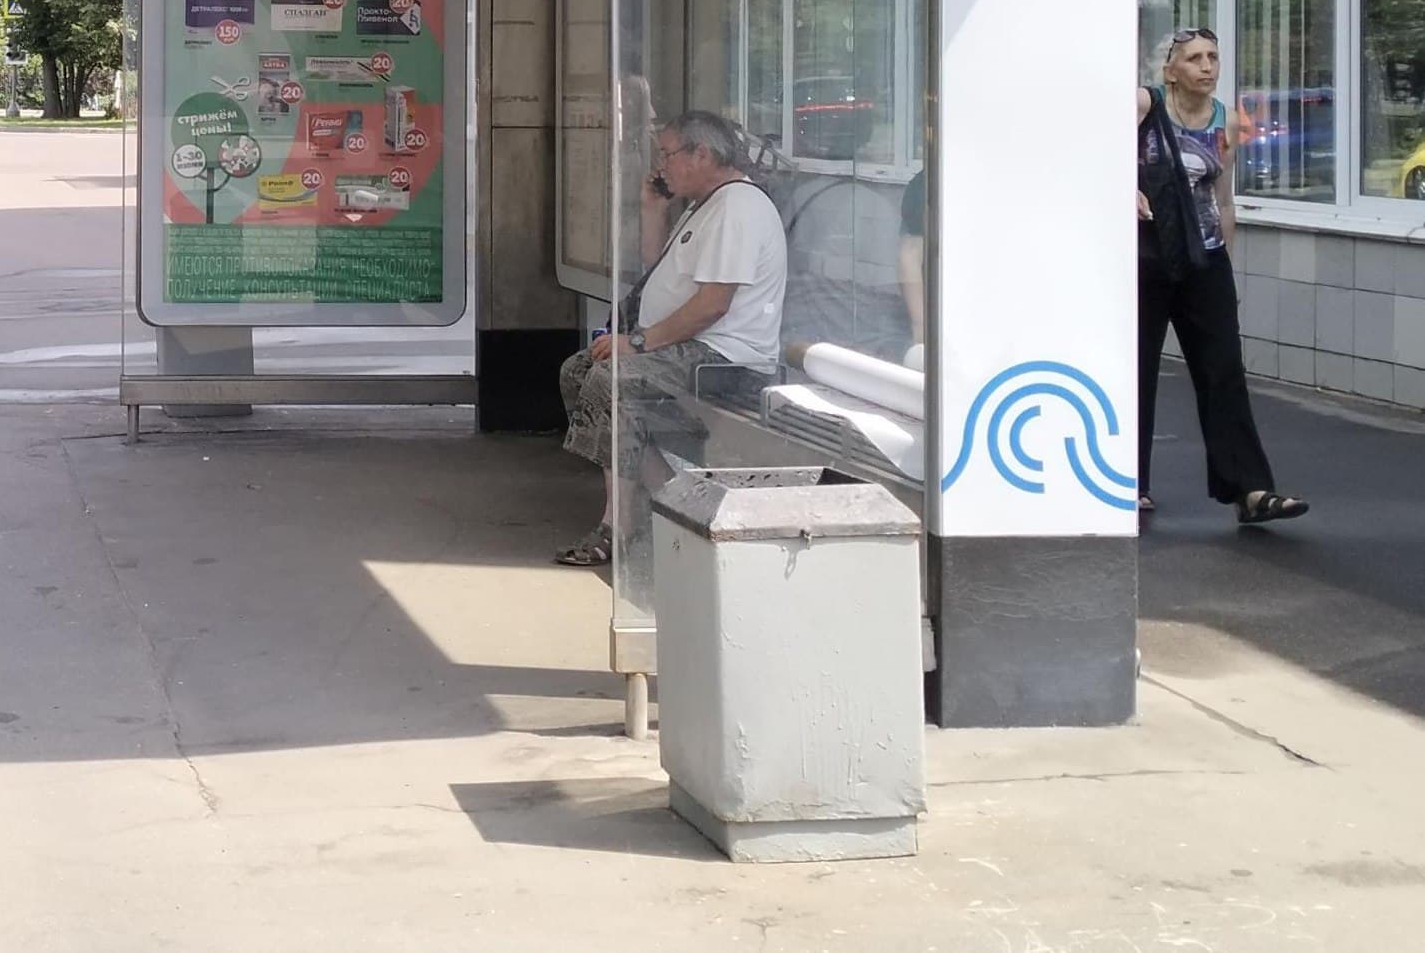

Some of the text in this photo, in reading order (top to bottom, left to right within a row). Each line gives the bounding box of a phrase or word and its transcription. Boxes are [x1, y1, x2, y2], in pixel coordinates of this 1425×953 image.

[218, 25, 239, 38] 150
[373, 57, 390, 69] 20
[282, 87, 301, 99] 20
[177, 109, 238, 127] стрижём
[191, 122, 232, 136] цены!
[348, 137, 365, 149] 20
[407, 133, 425, 146] 20
[303, 172, 320, 184] 20
[391, 171, 409, 183] 20
[166, 255, 223, 277] ИМЕЮТСЯ
